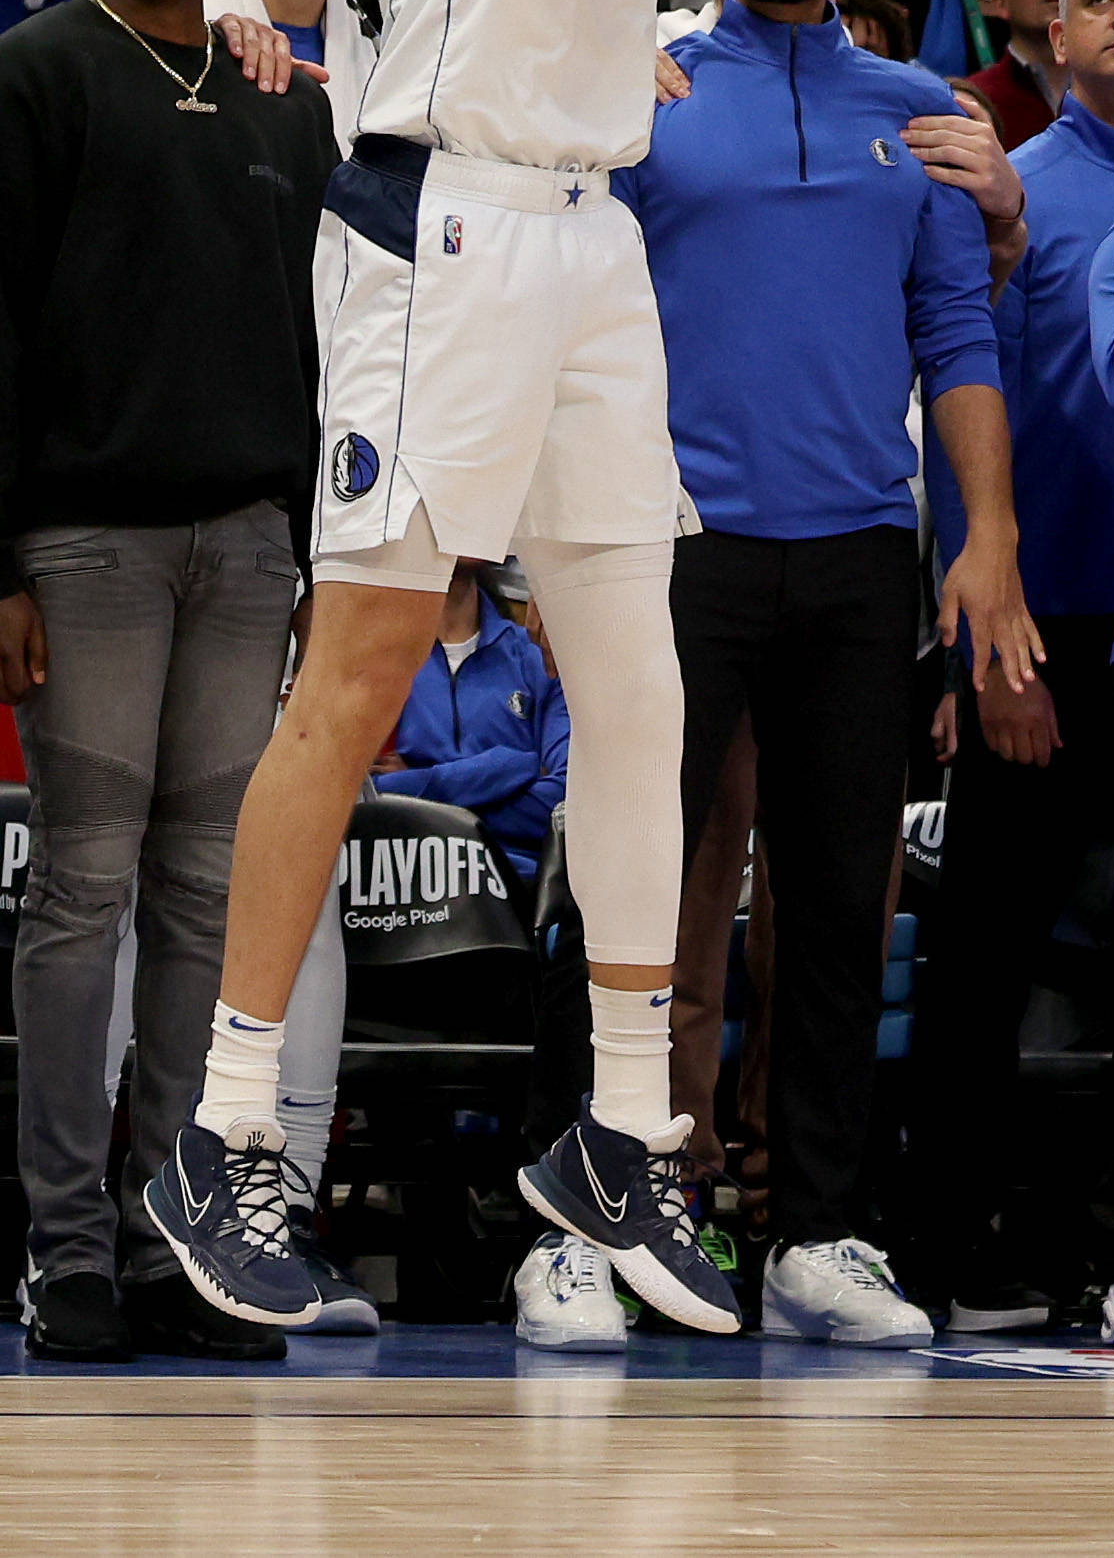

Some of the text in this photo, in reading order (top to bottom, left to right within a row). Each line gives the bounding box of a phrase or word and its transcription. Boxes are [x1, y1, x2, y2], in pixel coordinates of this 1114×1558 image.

[905, 843, 942, 870] Pixel
[343, 905, 450, 933] Google Pixel
